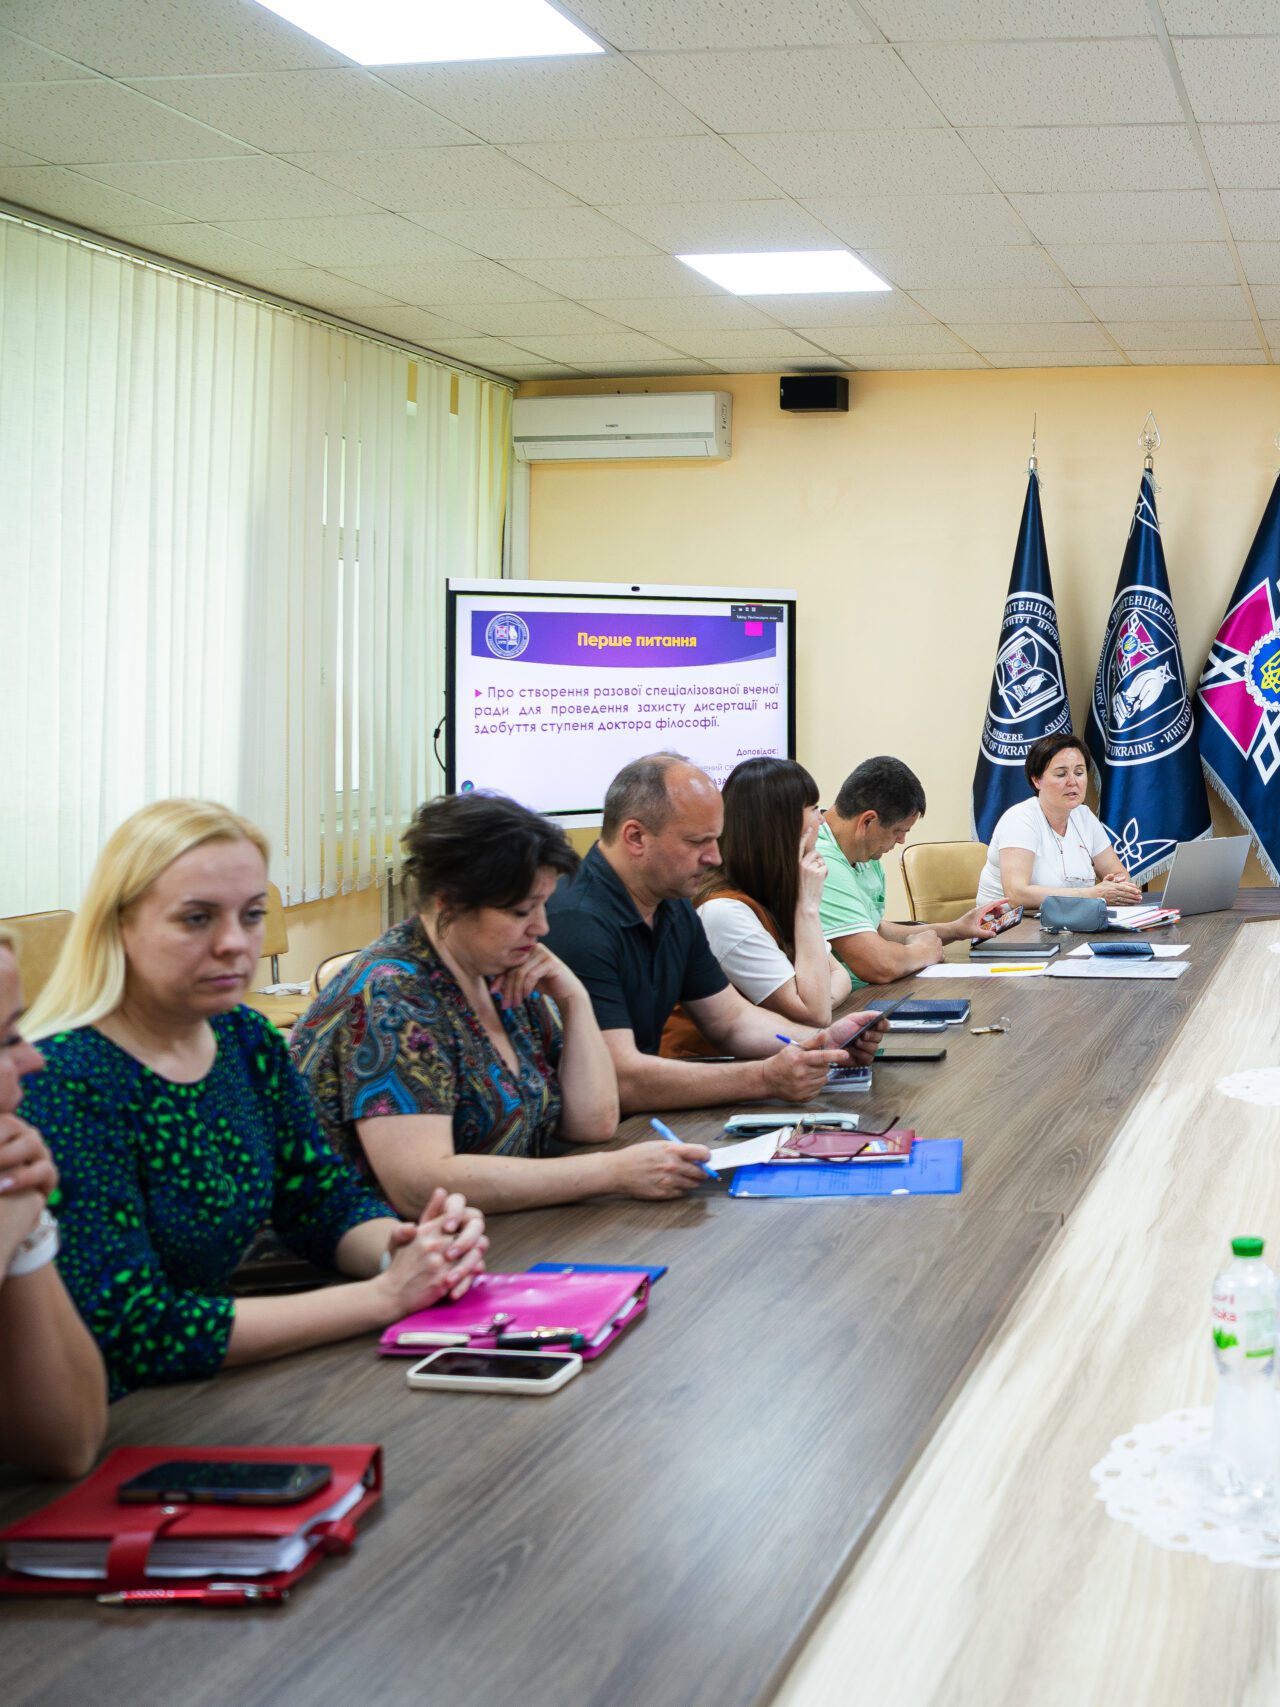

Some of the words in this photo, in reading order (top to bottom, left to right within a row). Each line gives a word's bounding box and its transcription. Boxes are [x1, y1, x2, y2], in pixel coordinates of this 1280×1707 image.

[577, 632, 632, 650] Перше
[636, 636, 697, 648] питання
[488, 686, 514, 700] Про
[519, 687, 589, 699] створення
[593, 684, 642, 699] разової
[645, 683, 741, 696] спеціалізованої
[743, 683, 779, 695] вченої
[474, 706, 509, 718] ради
[518, 706, 541, 716] для
[551, 704, 629, 716] проведення
[637, 703, 686, 714] захисту
[694, 700, 758, 713] дисертації
[764, 701, 778, 710] на
[474, 721, 536, 735] здобуття
[540, 721, 594, 734] ступеня
[598, 720, 651, 732] доктора
[655, 715, 720, 731] філософії.
[992, 728, 1024, 741] DISCERE
[1110, 741, 1155, 756] UKRAINE
